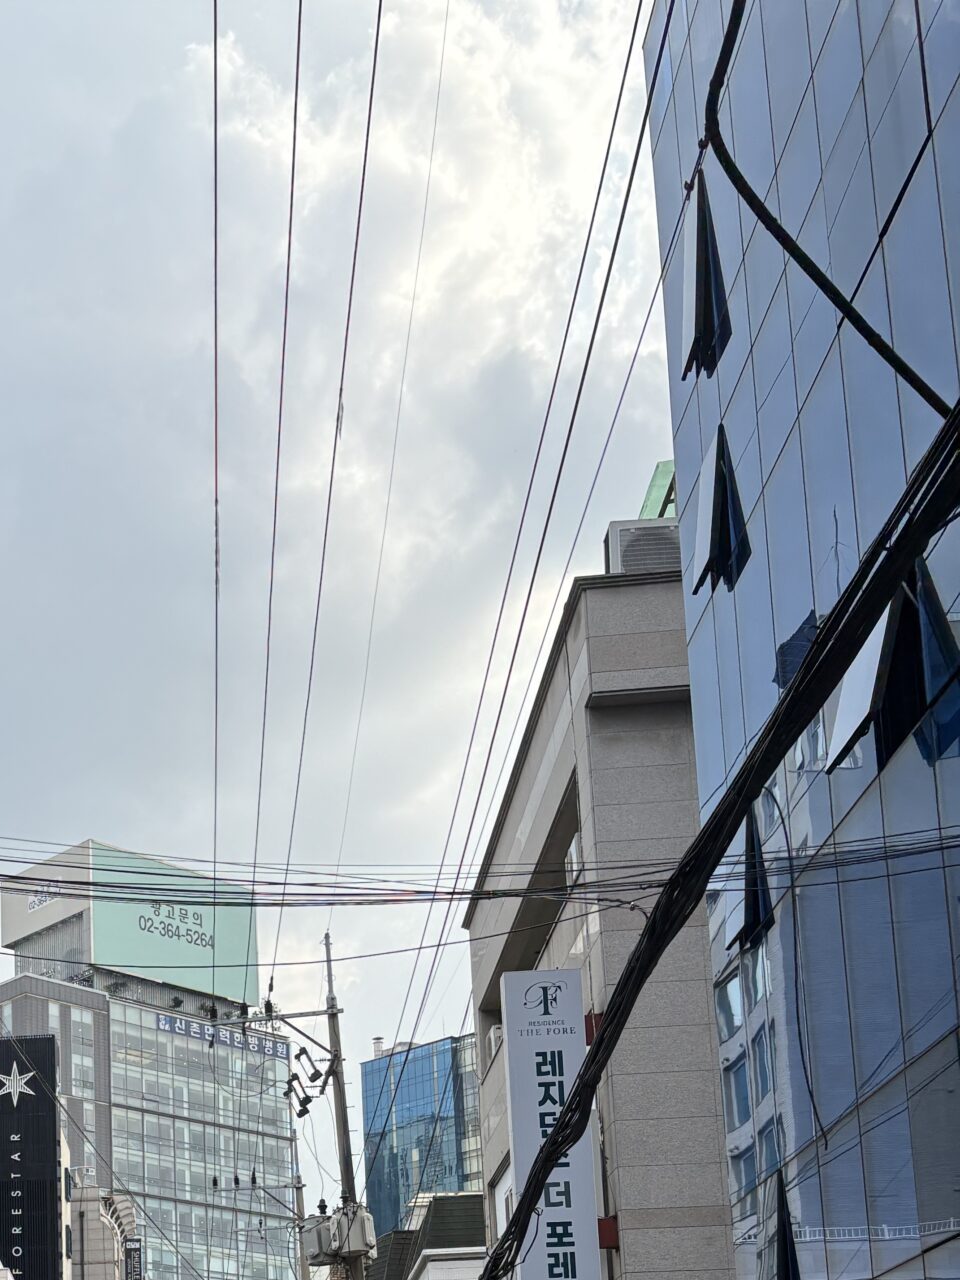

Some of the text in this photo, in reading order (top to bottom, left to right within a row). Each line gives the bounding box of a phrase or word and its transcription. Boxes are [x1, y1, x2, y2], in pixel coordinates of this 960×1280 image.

[138, 914, 216, 950] 02-364-5264
[517, 1026, 577, 1037] THE FORE
[528, 1019, 566, 1027] RESIDENCE
[9, 1133, 24, 1275] FORESTAR
[544, 1180, 572, 1209] 더
[545, 1220, 578, 1280] 포레
